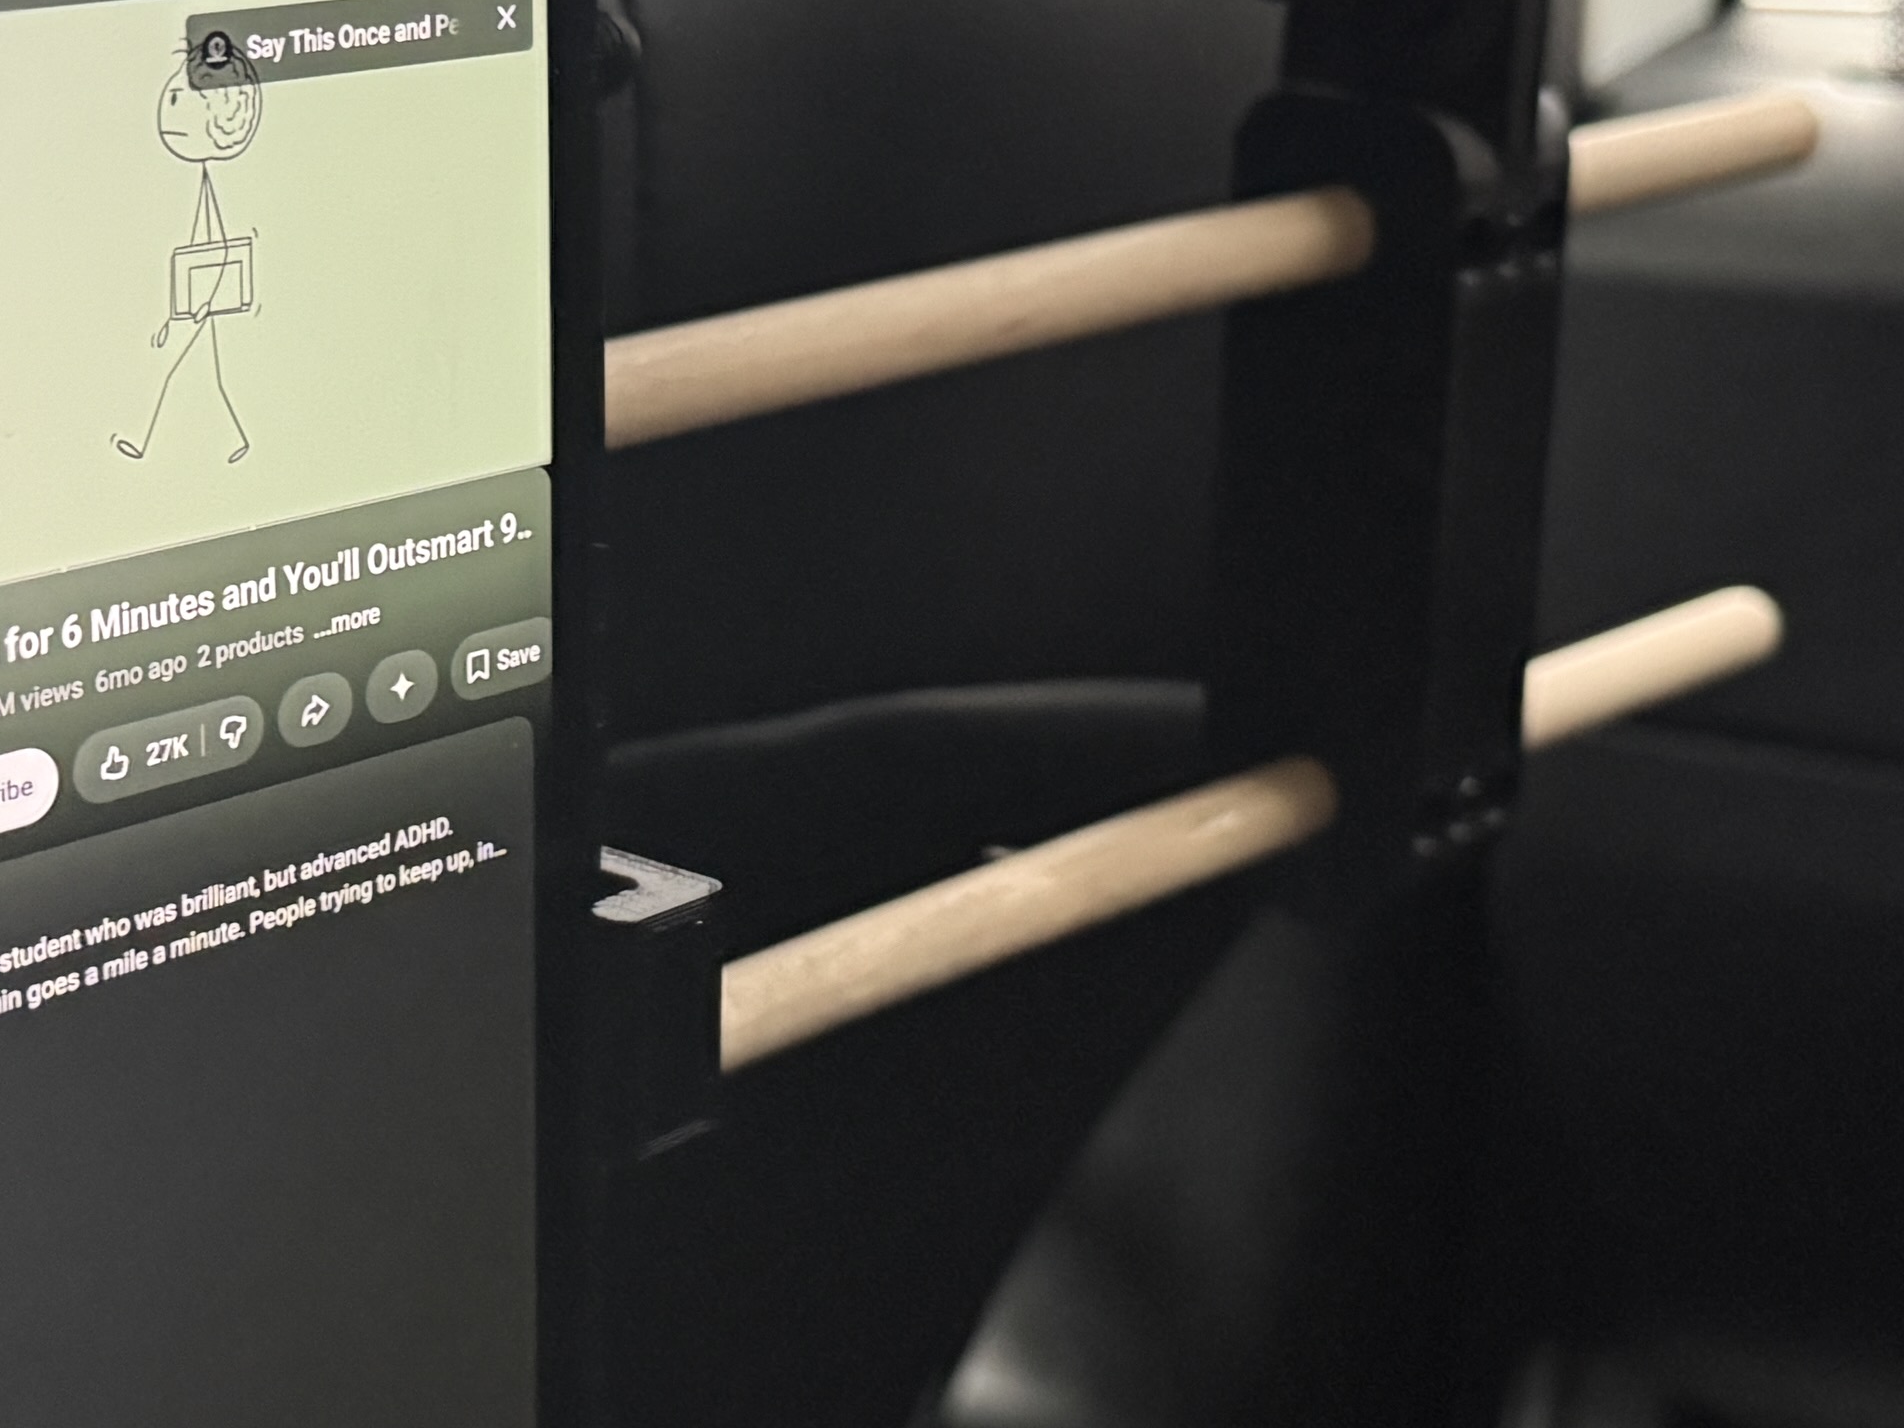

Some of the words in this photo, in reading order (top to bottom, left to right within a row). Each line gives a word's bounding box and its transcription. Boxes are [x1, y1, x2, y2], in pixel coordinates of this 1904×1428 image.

[247, 34, 285, 63] Say
[289, 25, 335, 55] This
[338, 23, 390, 49] Once
[395, 14, 431, 42] and
[4, 625, 54, 663] for
[61, 613, 82, 649] 6
[90, 590, 215, 643] Minutes
[221, 567, 277, 611] and
[282, 547, 360, 596] You'll
[367, 519, 495, 575] Outsmart
[20, 678, 85, 713] views
[95, 665, 144, 693] 6mo
[148, 655, 188, 682] ago
[197, 644, 212, 668] 2
[215, 623, 304, 668] products
[496, 644, 540, 671] Save
[146, 733, 189, 767] 27K
[84, 916, 131, 946] who
[133, 902, 178, 931] was
[181, 876, 261, 917] brilliant,
[264, 864, 297, 893] but
[300, 833, 391, 881] advanced
[394, 816, 453, 853] ADHD.
[26, 970, 80, 1009] goes
[84, 966, 99, 986] a
[102, 948, 149, 981] mile
[152, 945, 167, 966] a
[170, 922, 246, 960] minute.
[249, 895, 317, 934] People
[319, 879, 373, 914] trying
[375, 873, 397, 894] to
[399, 857, 443, 889] keep
[446, 849, 474, 874] up,
